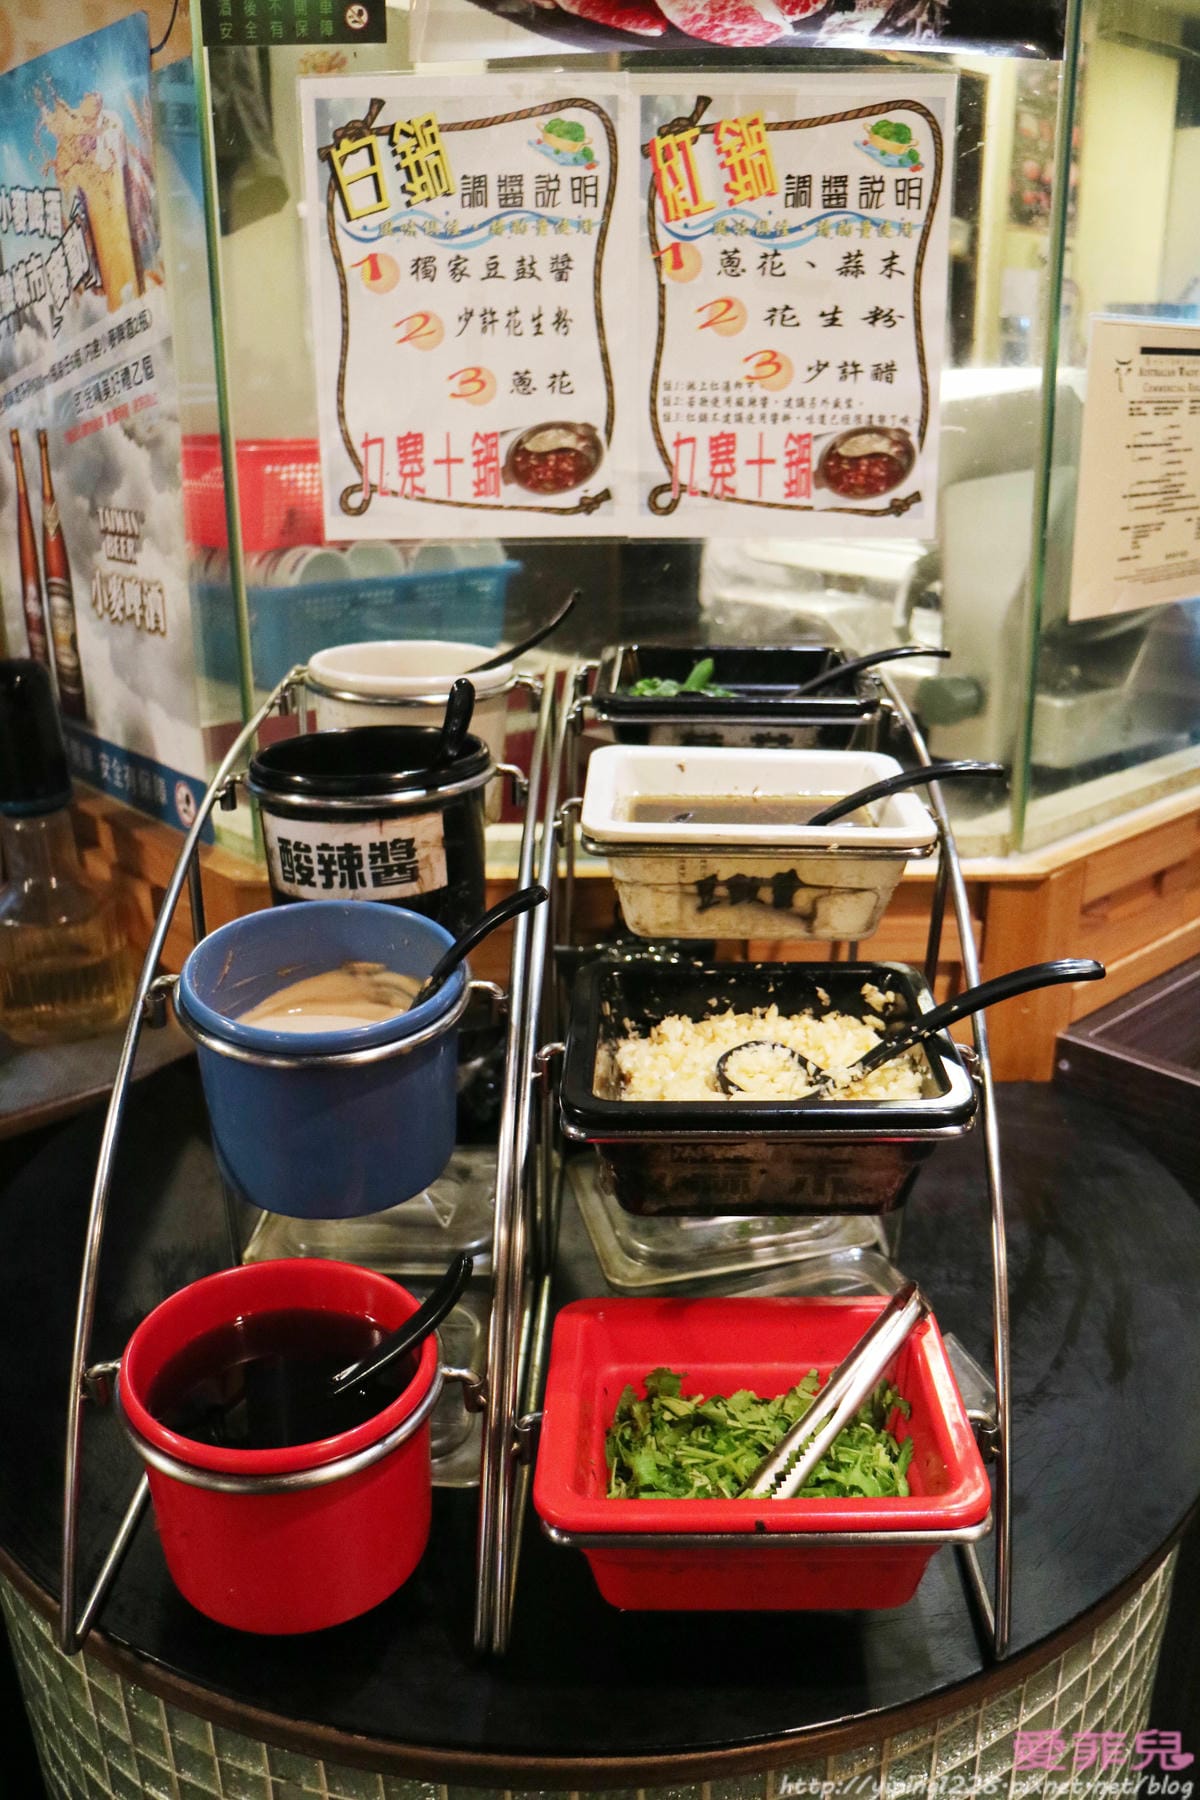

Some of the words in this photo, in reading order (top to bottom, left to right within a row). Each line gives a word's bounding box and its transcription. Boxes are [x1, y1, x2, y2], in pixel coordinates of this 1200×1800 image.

[219, 20, 335, 39] 安全有保障
[331, 111, 456, 222] 白鍋
[460, 174, 599, 209] 調醬說明
[649, 109, 779, 223] 紅鍋
[784, 174, 923, 210] 調醬說明
[349, 252, 382, 281] 1
[652, 242, 684, 271] 1
[716, 249, 907, 279] 蔥花、蒜末
[393, 312, 435, 344] 2
[454, 306, 574, 337] 少許花生粉
[695, 297, 739, 331] 2
[762, 304, 906, 328] 花生粉
[448, 365, 487, 398] 3
[509, 370, 575, 396] 蔥花
[742, 349, 783, 381] 3
[803, 359, 899, 385] 少許醋
[361, 431, 500, 498] 九寨十鍋
[672, 431, 813, 499] 九寨十鍋
[103, 536, 137, 564] BEER
[91, 569, 168, 637] 小麥啤酒
[277, 837, 419, 890] 酸辣醬
